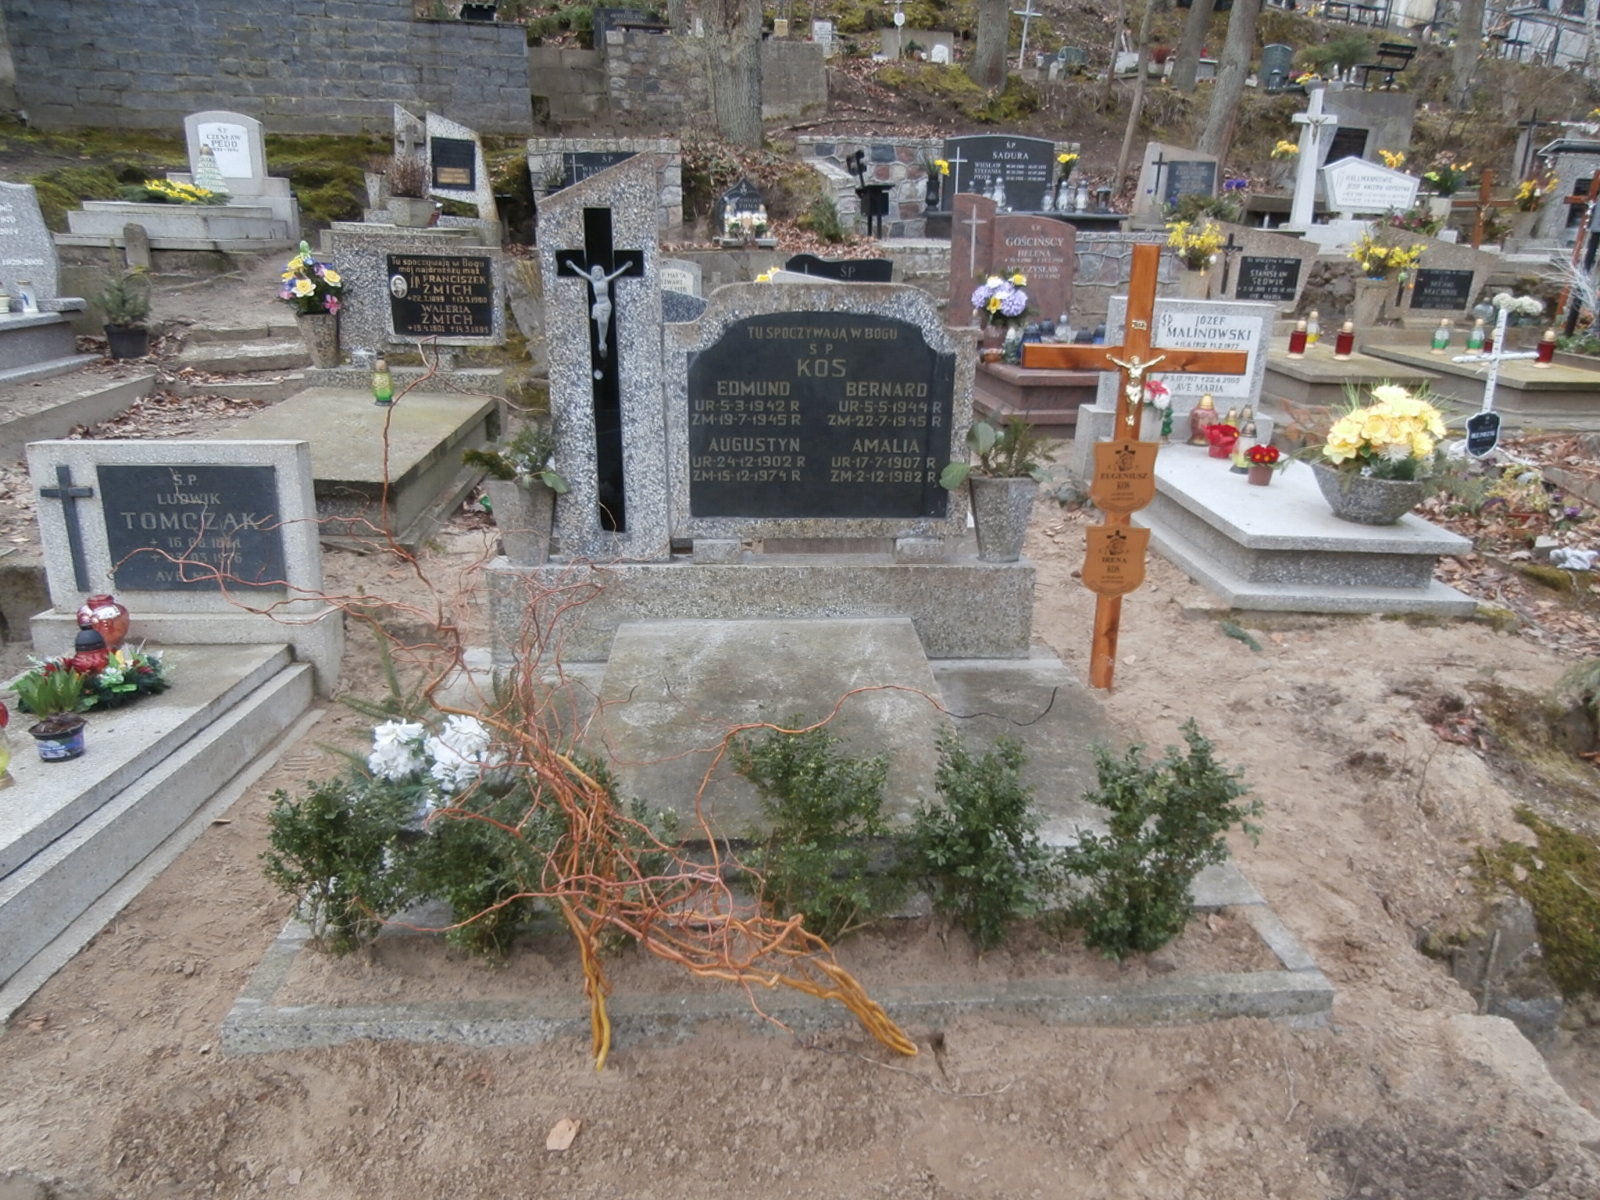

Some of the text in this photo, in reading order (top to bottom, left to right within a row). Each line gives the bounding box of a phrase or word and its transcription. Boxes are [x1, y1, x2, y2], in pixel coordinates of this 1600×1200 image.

[992, 151, 1029, 160] SADURA
[422, 274, 487, 285] FRANCISZEK
[421, 304, 472, 314] WALERIA
[748, 326, 898, 342] TU SPOCZYWAJĄ W BOGU
[1166, 326, 1252, 341] MALINOWSKI
[797, 359, 847, 377] KOS
[717, 381, 791, 396] EDMUND
[846, 382, 928, 398] BERNARD
[1195, 384, 1224, 393] MARIA
[709, 437, 800, 452] AUGUSTYN
[852, 438, 920, 453] AMALIA
[157, 493, 221, 505] LUDWIK
[120, 511, 259, 530] TOMCZAK
